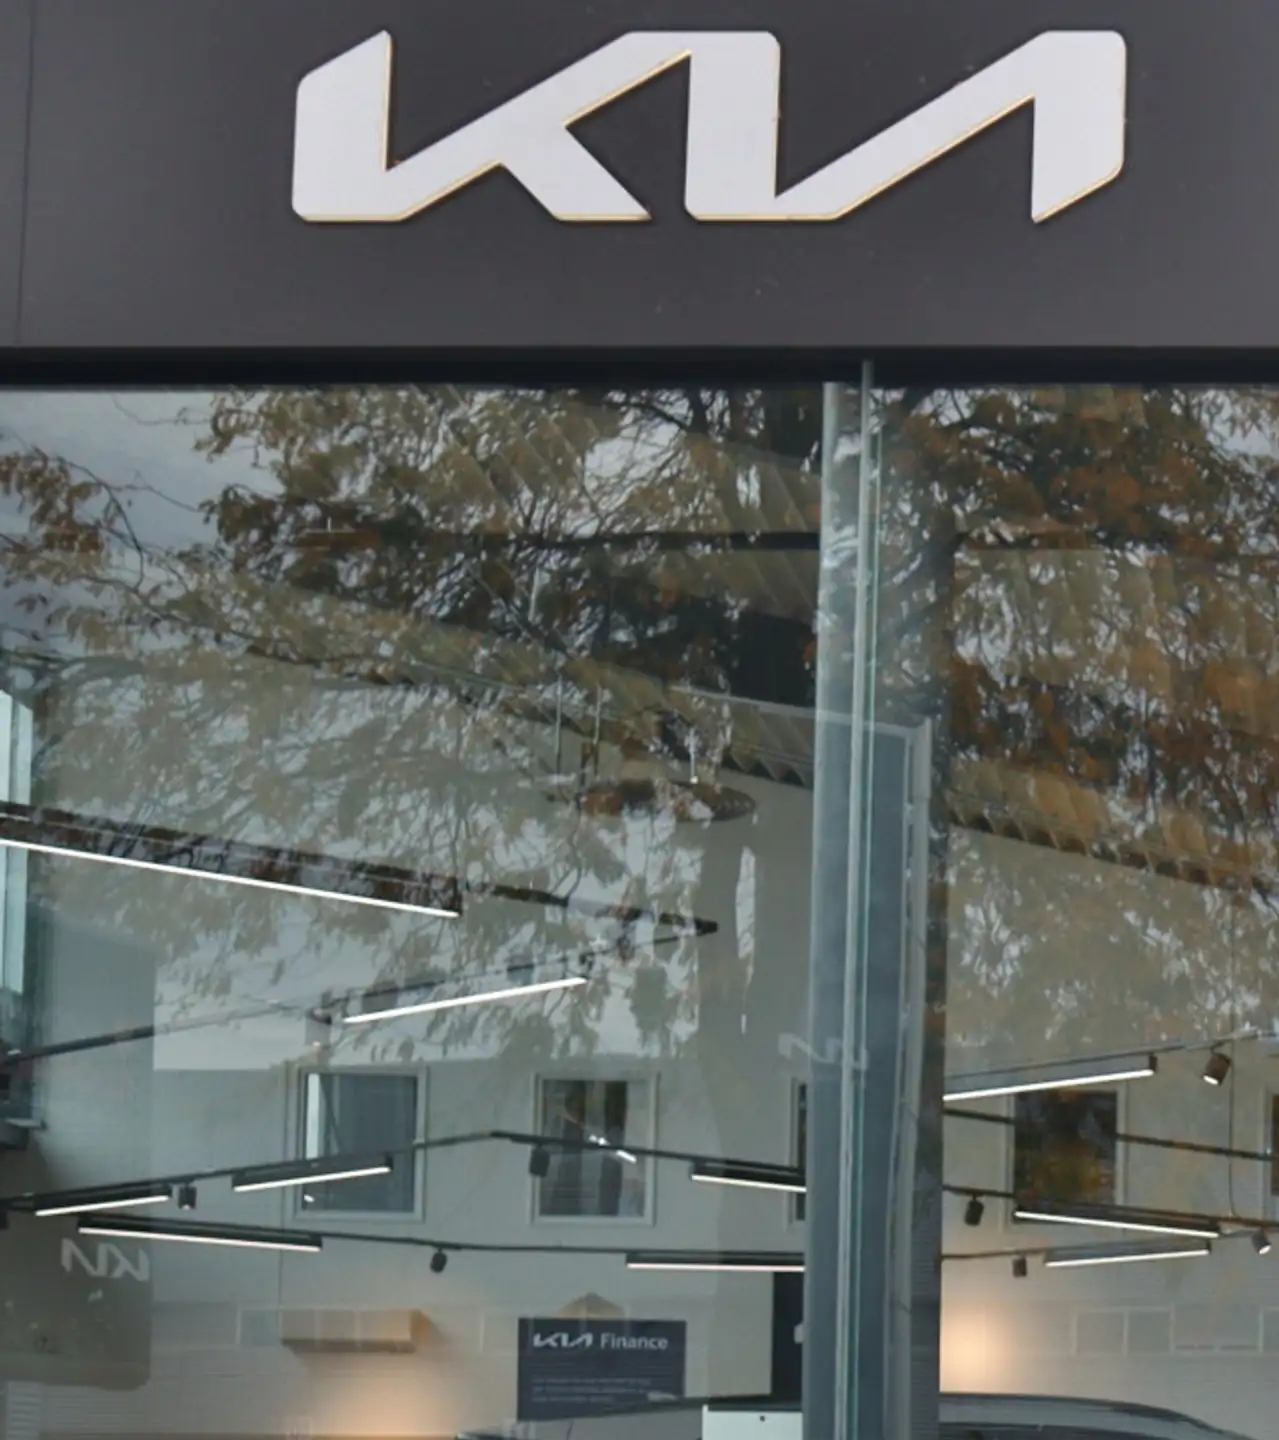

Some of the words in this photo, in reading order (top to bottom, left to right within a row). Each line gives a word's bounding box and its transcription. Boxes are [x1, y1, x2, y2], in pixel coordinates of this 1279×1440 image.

[291, 29, 1127, 224] KIA
[533, 1332, 594, 1348] KIA
[600, 1333, 669, 1351] Finance
